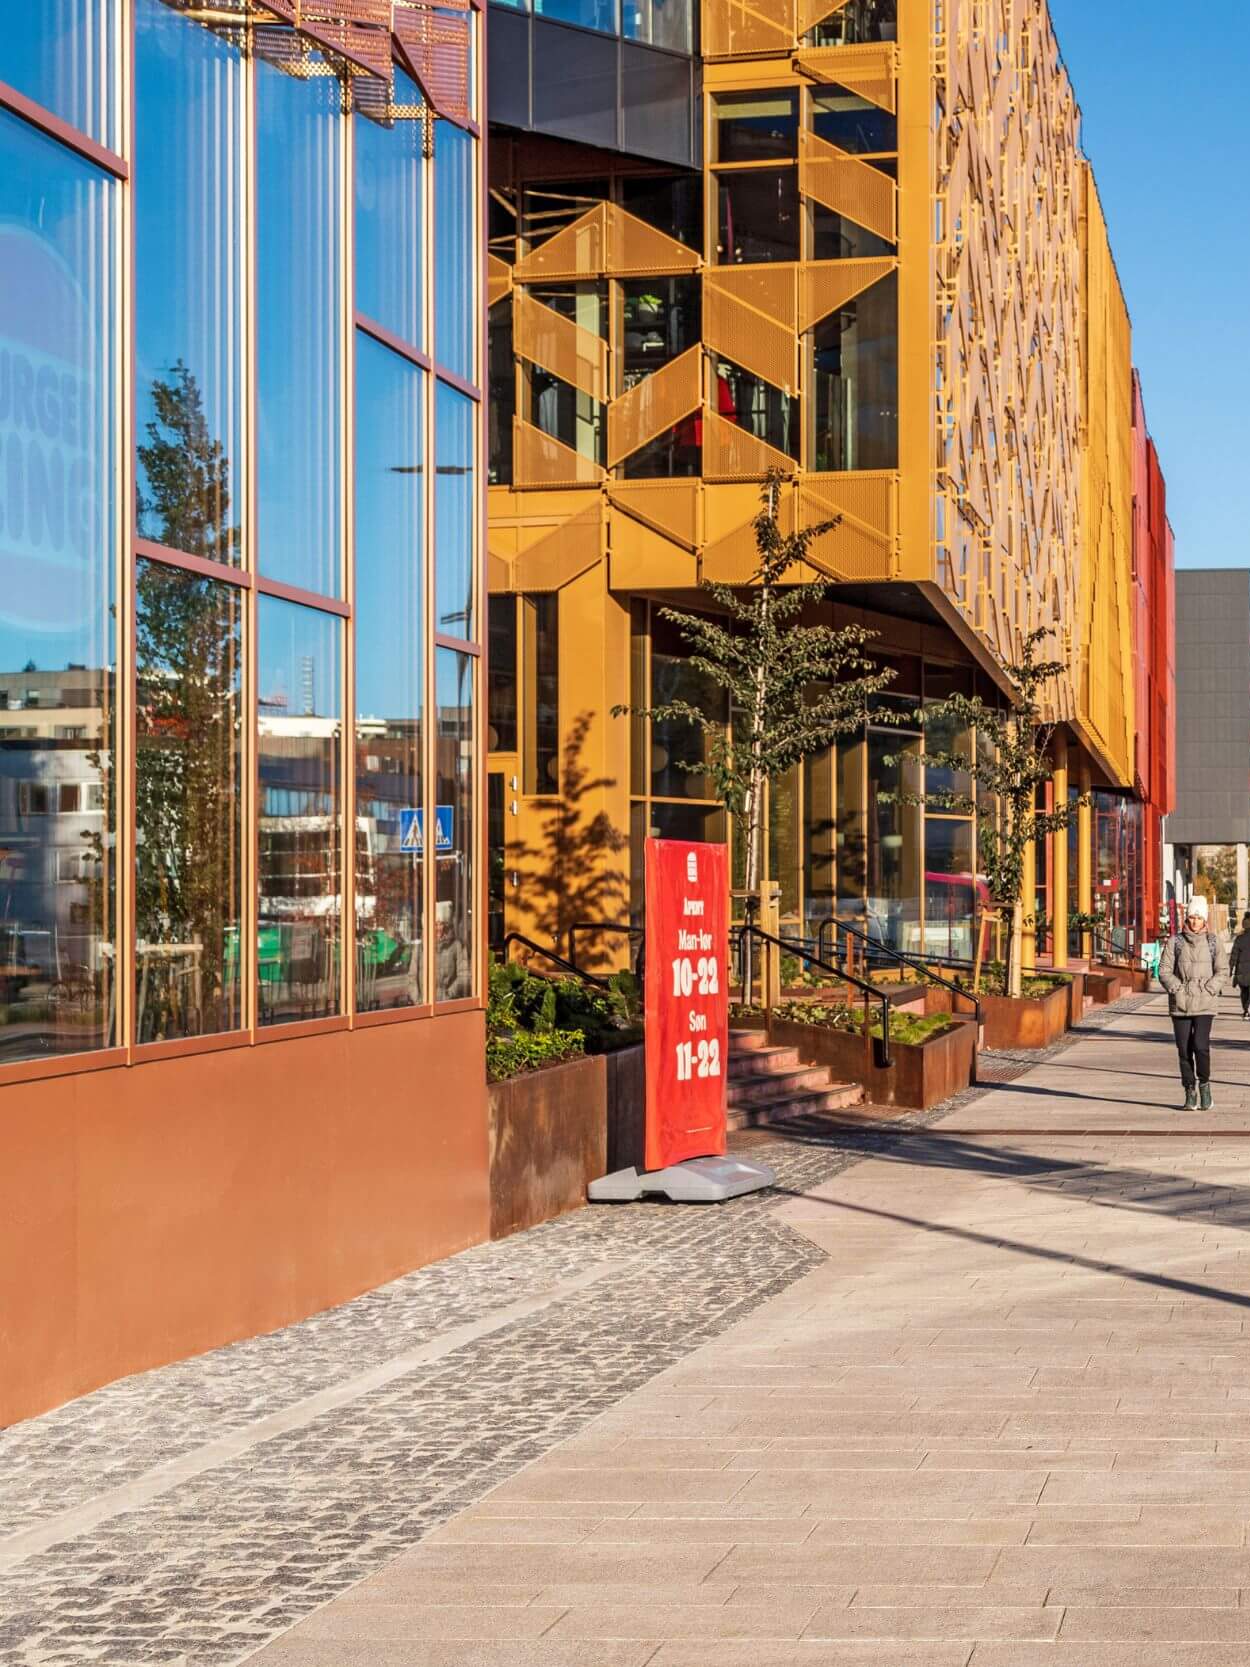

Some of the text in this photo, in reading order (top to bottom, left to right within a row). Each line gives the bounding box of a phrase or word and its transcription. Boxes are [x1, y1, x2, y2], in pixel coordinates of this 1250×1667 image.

[672, 957, 719, 997] 10-22
[688, 1010, 707, 1032] Søn
[676, 1039, 720, 1081] 11-22
